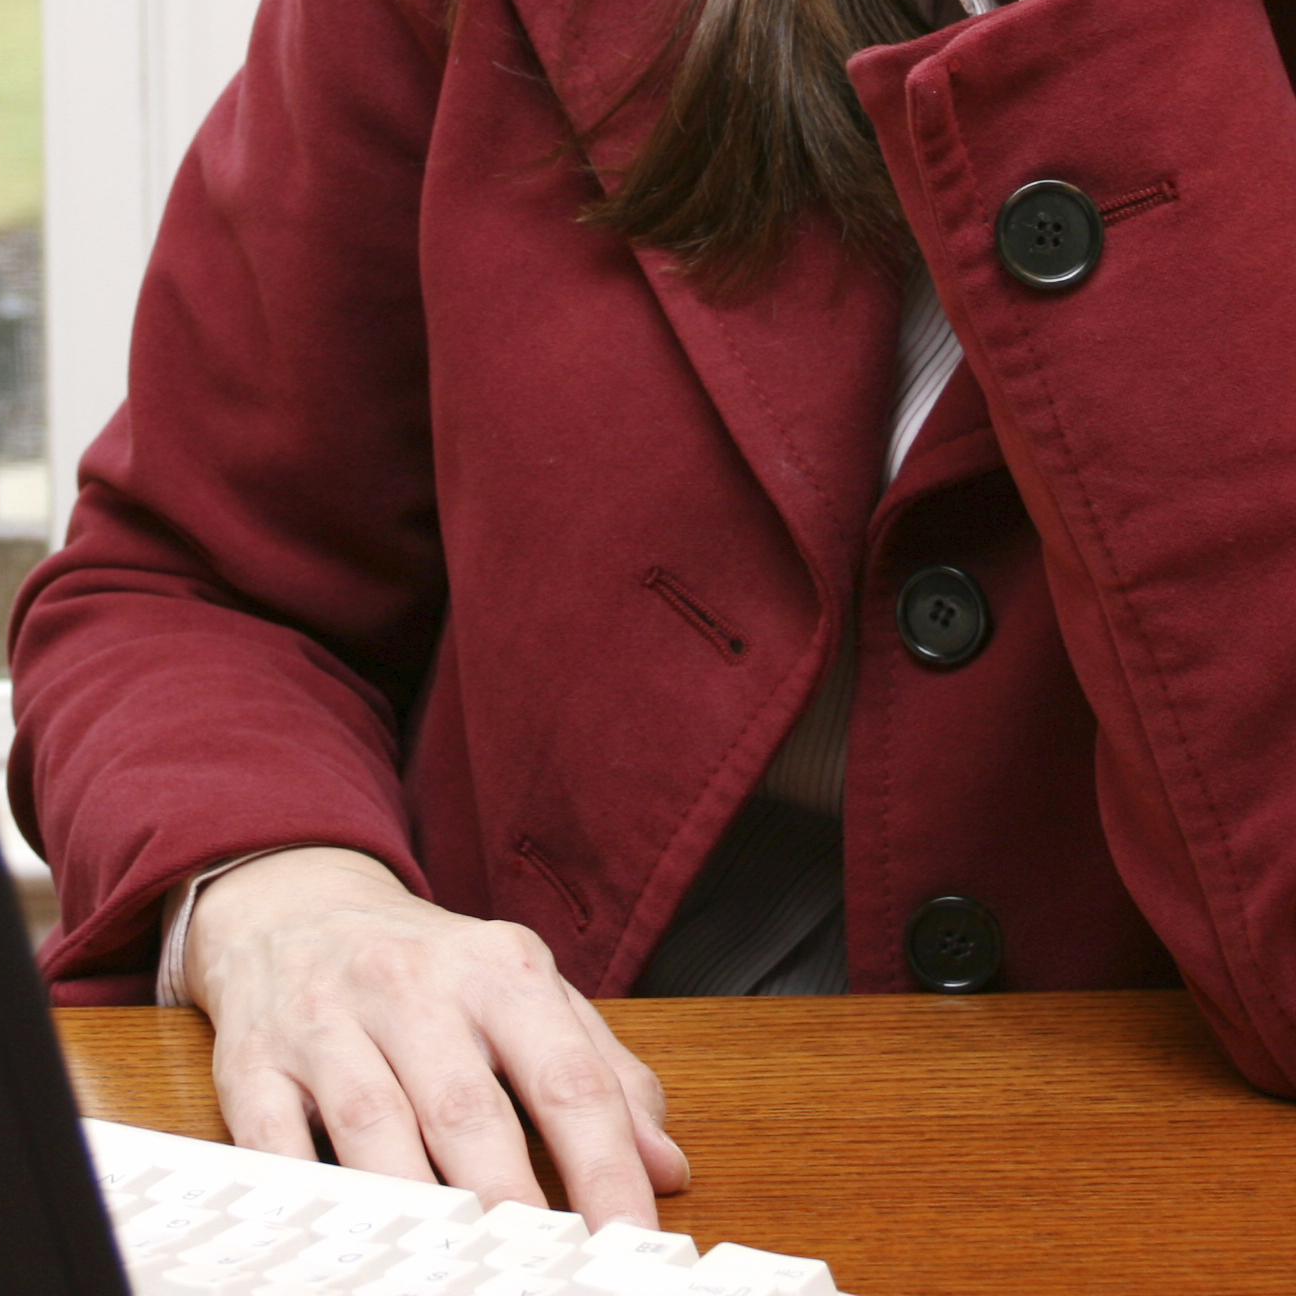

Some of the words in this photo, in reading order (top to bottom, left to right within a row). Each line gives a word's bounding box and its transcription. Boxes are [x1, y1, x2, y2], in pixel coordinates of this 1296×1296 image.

[181, 1189, 206, 1200] B
[263, 1206, 285, 1217] V
[166, 1219, 191, 1229] G
[348, 1222, 373, 1234] C
[433, 1238, 461, 1250] X
[337, 1253, 364, 1263] D
[521, 1255, 548, 1268] Z
[426, 1271, 449, 1282] S
